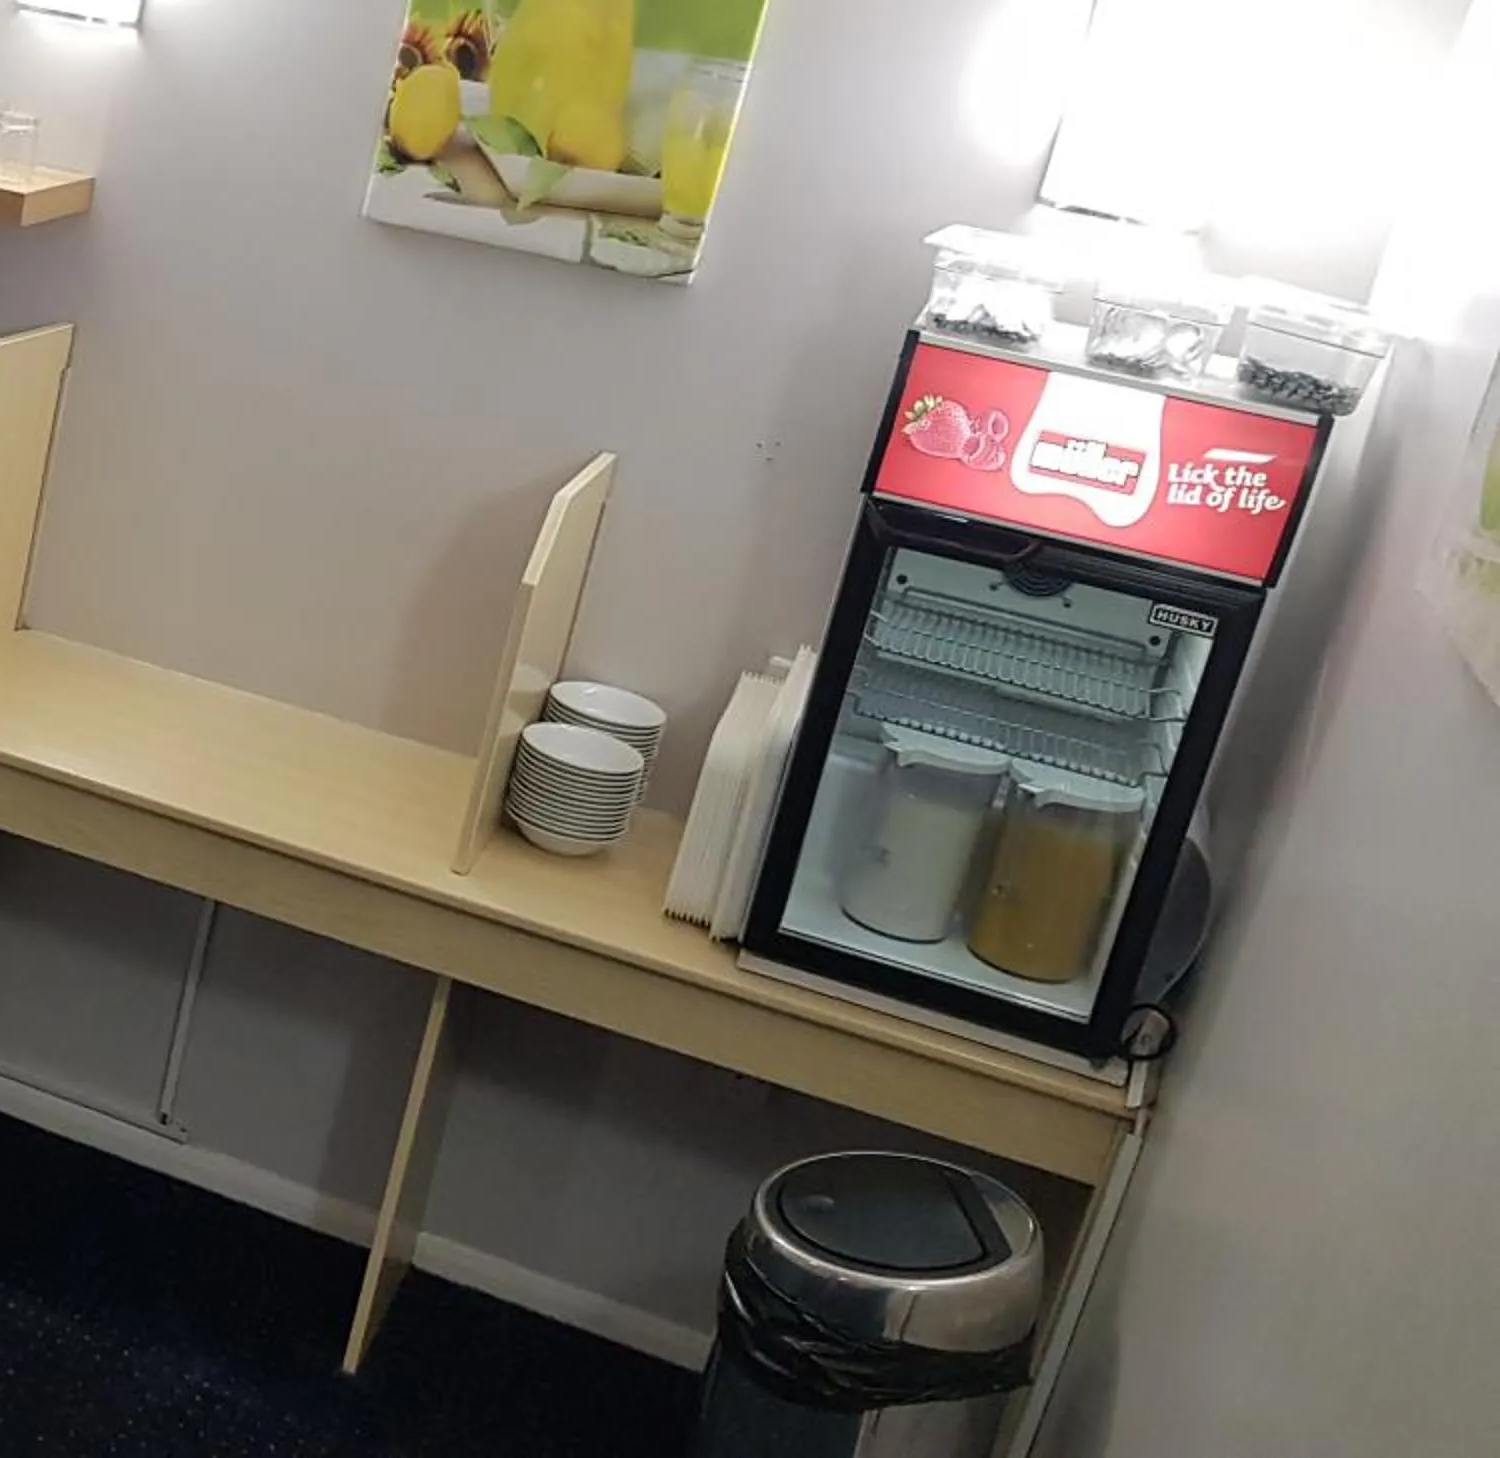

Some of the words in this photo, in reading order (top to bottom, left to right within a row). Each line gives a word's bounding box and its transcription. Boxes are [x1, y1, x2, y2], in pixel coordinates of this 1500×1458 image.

[1167, 462, 1220, 490] Lick
[1223, 466, 1268, 487] the
[1167, 483, 1202, 505] lid
[1205, 487, 1237, 512] of
[1238, 488, 1287, 515] life
[1155, 608, 1212, 631] HUSKY
